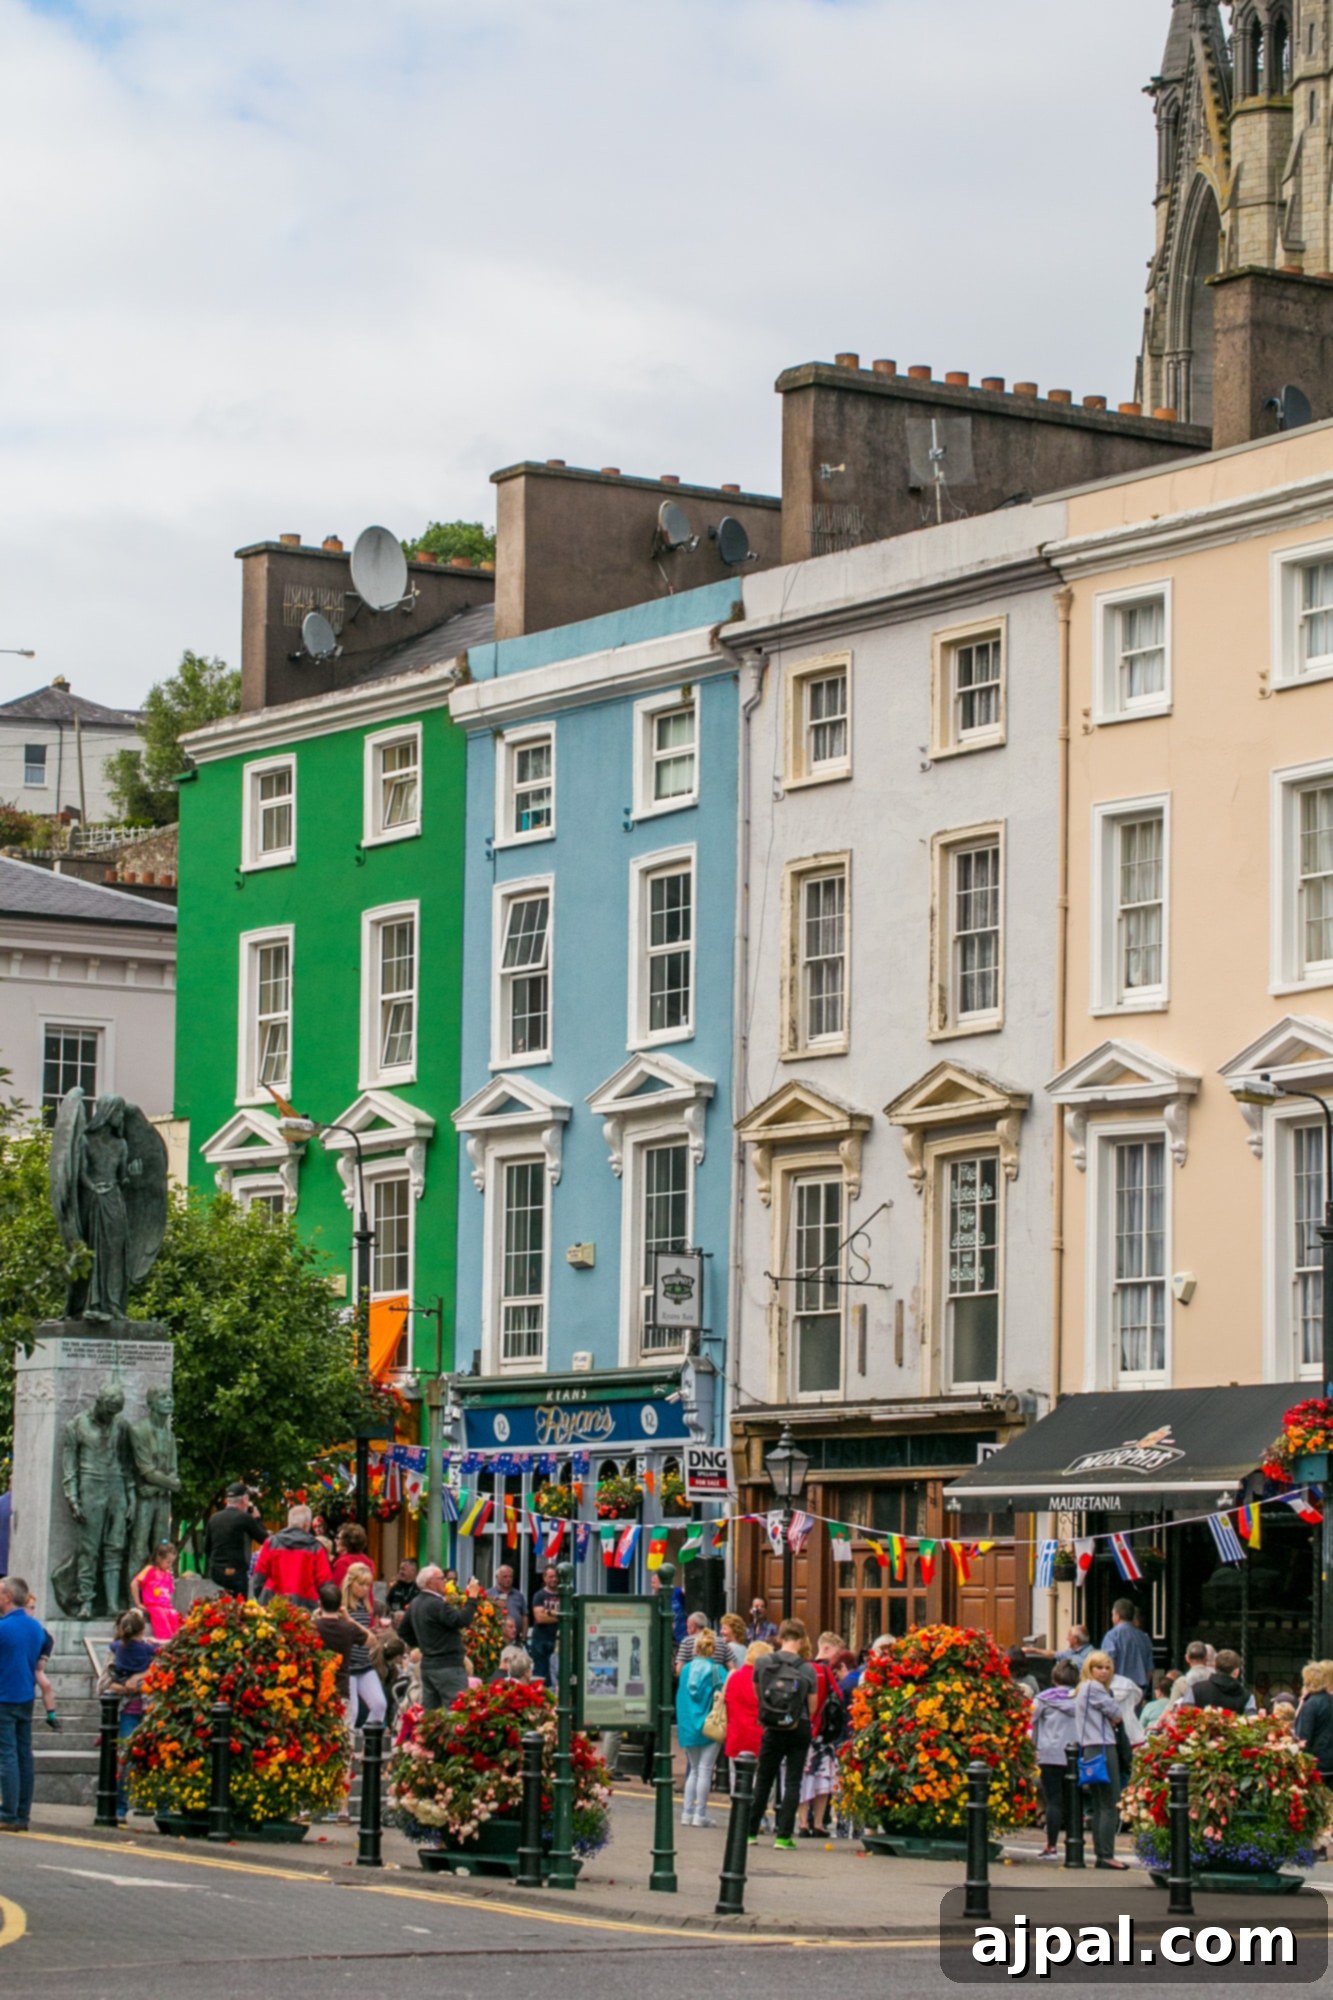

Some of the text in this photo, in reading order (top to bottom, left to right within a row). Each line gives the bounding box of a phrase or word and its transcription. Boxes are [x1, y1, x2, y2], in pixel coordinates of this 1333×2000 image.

[546, 1389, 587, 1401] RYANS
[535, 1405, 616, 1444] Ryan's
[689, 1450, 727, 1468] DNG
[1048, 1495, 1121, 1511] MAURETANIA
